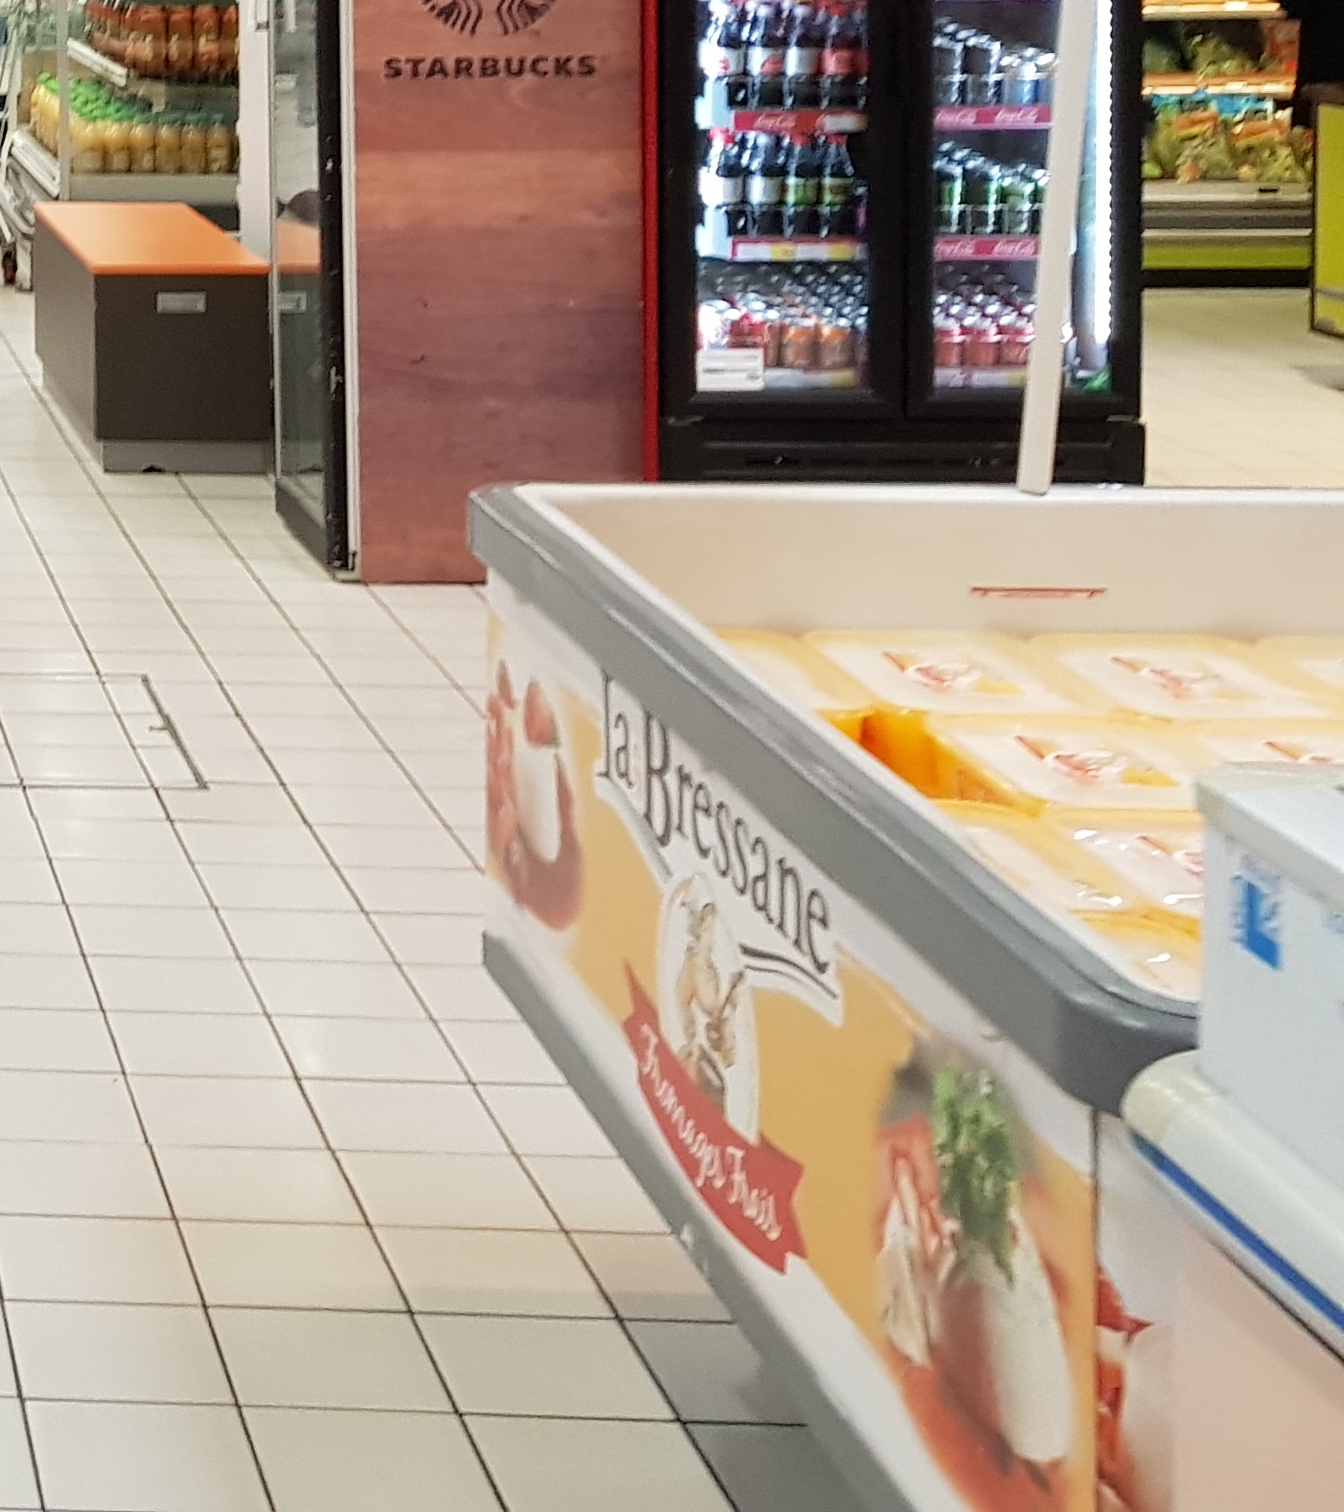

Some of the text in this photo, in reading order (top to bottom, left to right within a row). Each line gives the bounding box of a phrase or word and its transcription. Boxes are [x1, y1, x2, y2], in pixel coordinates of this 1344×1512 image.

[383, 54, 598, 80] STARBUCKS
[596, 668, 830, 974] la Bressane
